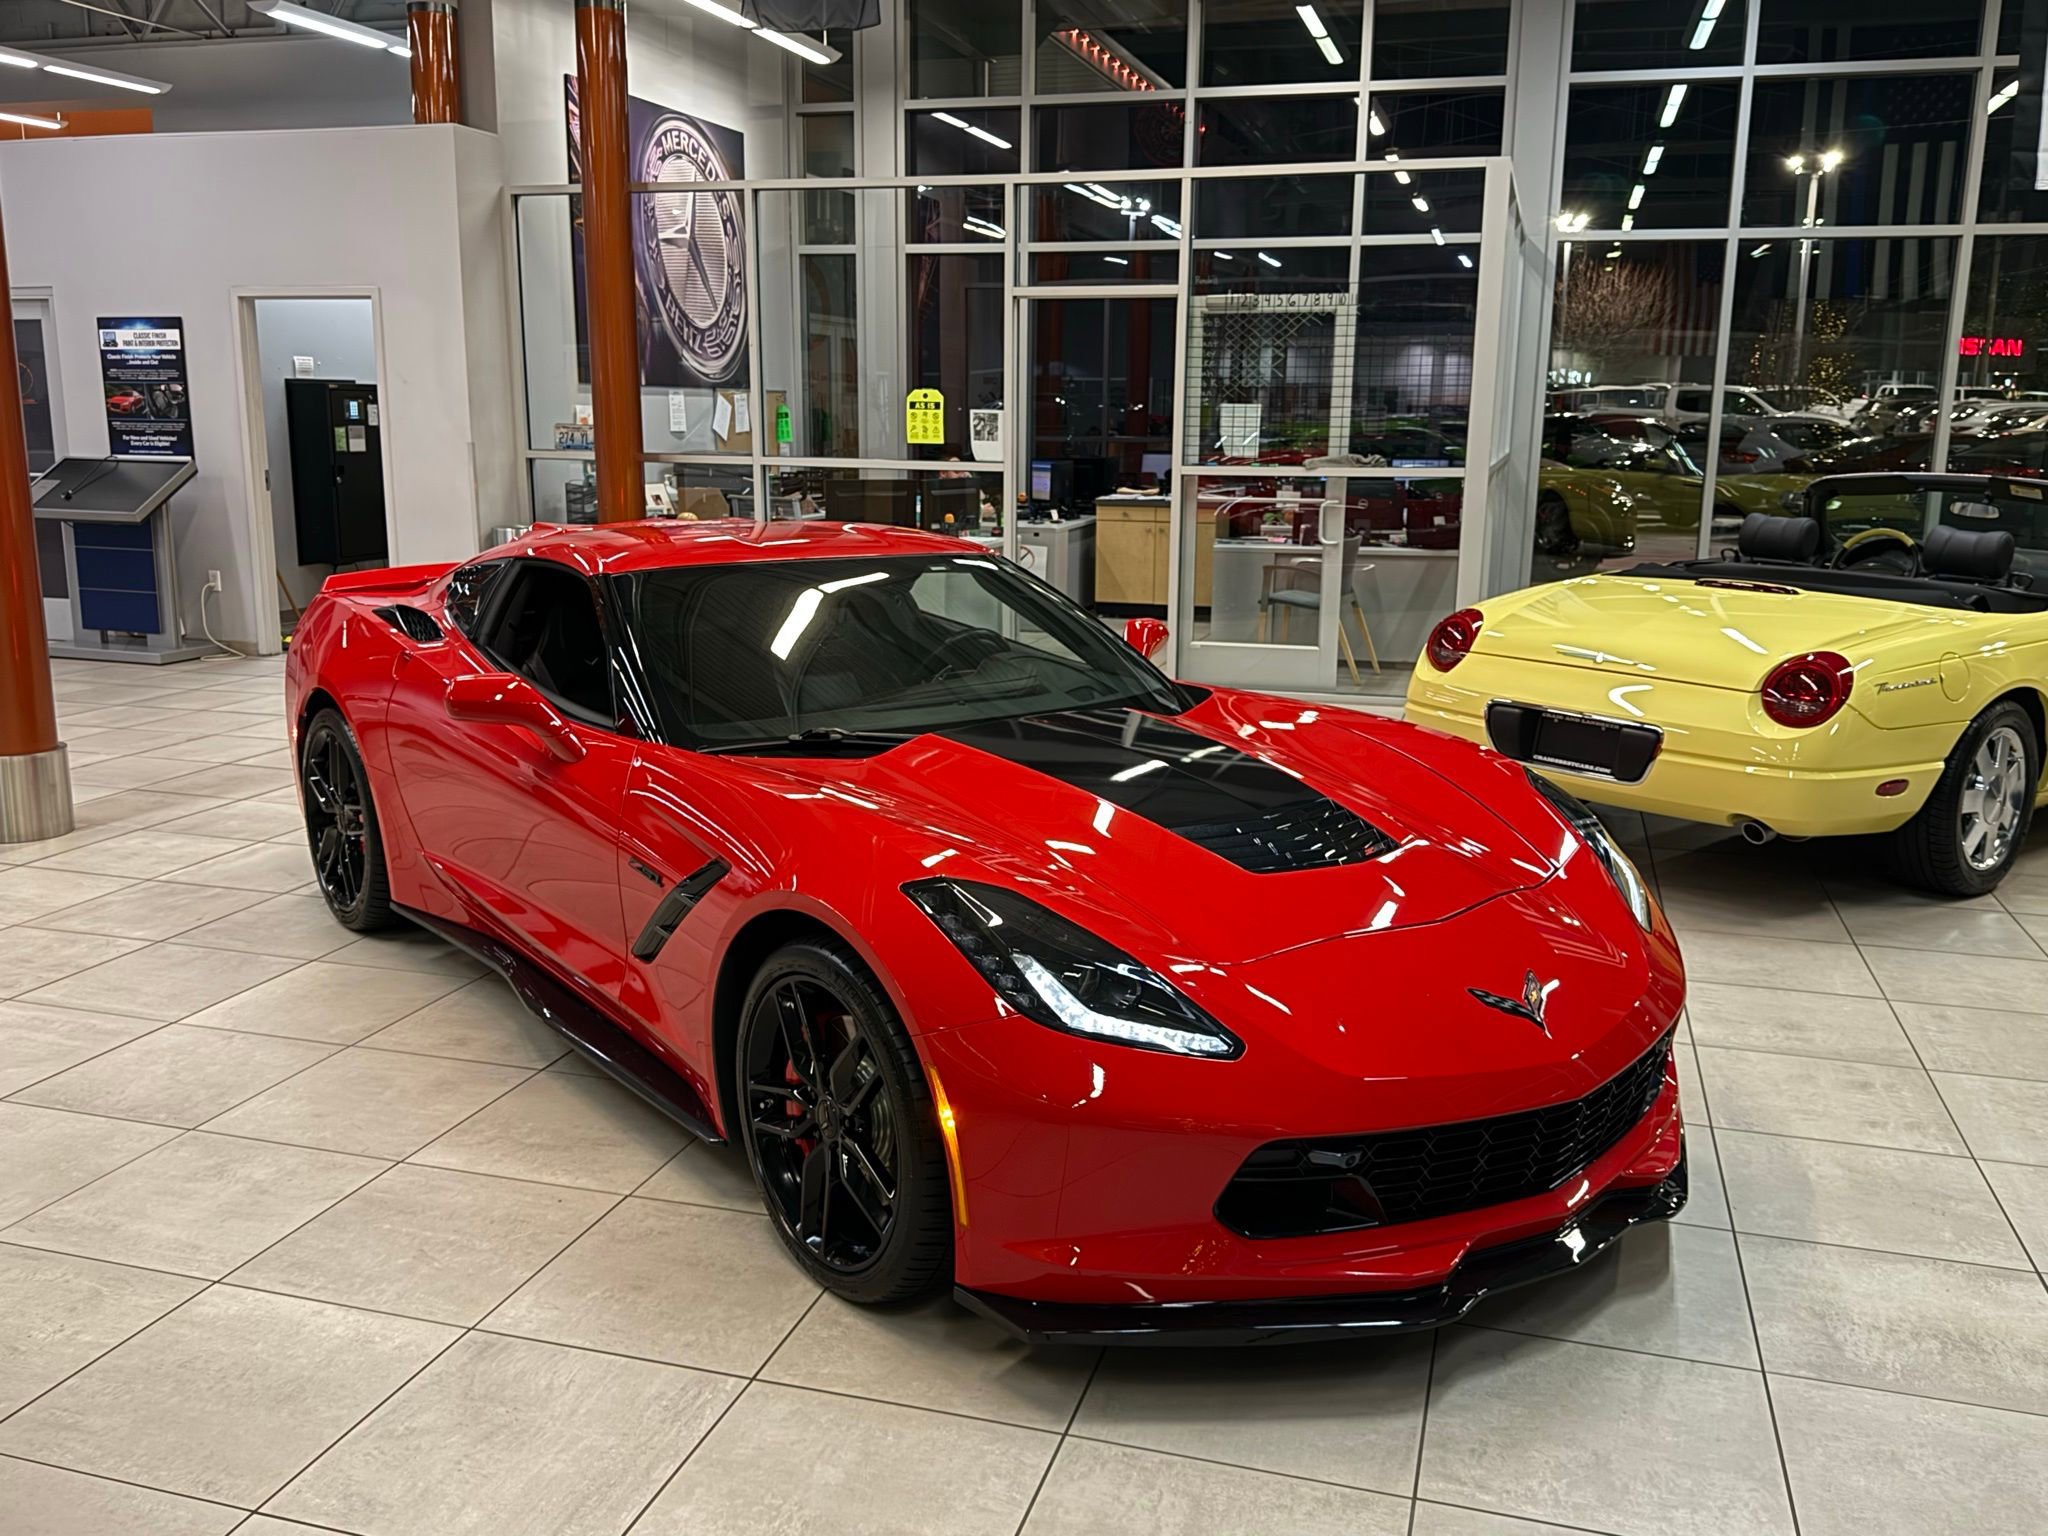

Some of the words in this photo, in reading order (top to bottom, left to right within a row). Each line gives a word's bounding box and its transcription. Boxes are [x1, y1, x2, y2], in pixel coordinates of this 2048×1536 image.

[661, 130, 730, 220] MERCEDS
[665, 293, 702, 354] BENZ
[559, 431, 575, 444] 274
